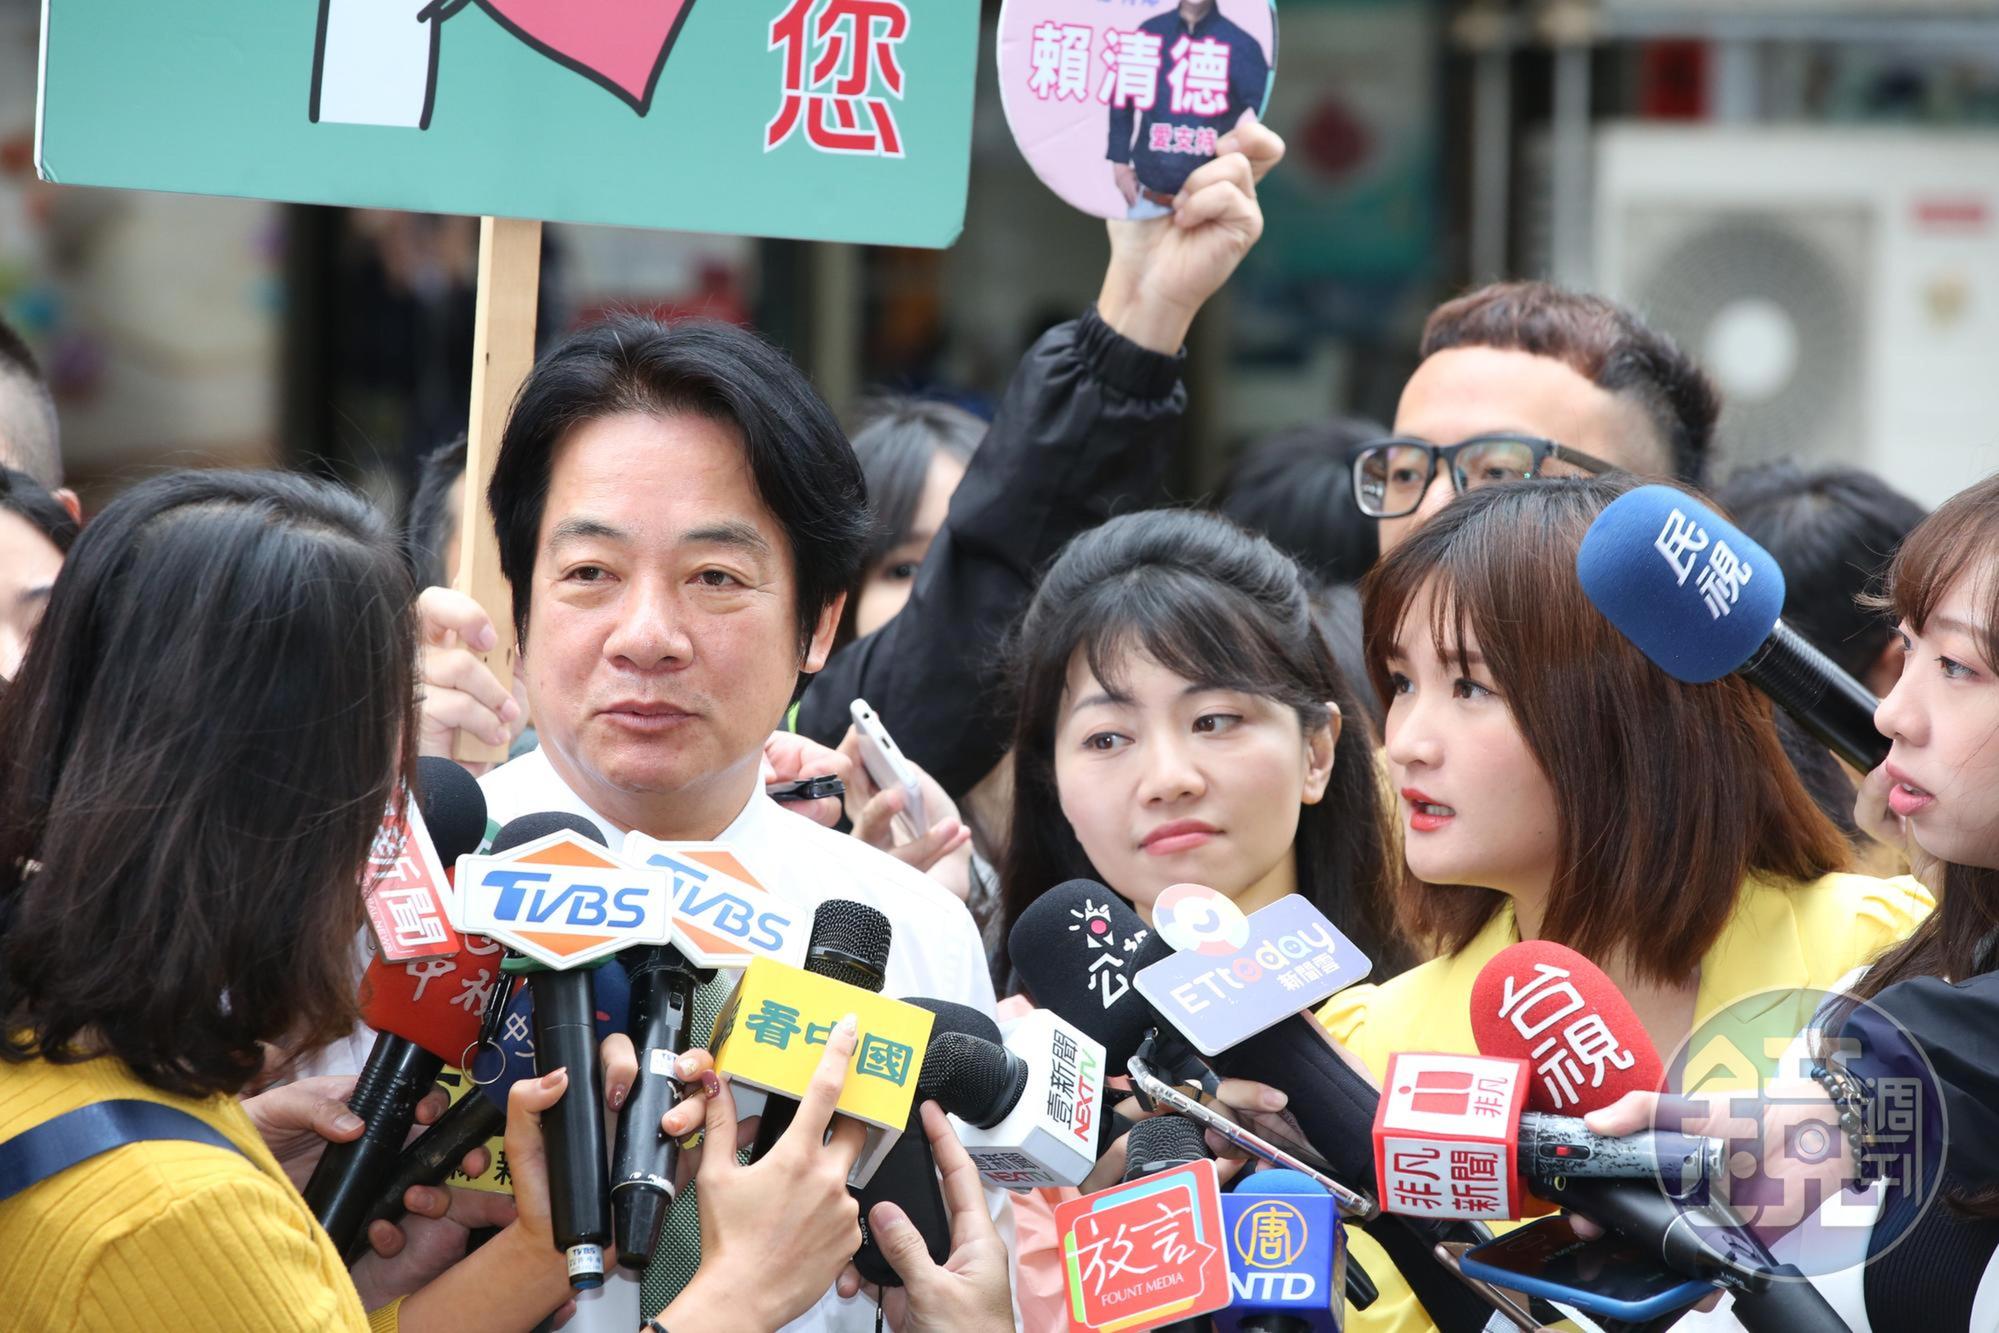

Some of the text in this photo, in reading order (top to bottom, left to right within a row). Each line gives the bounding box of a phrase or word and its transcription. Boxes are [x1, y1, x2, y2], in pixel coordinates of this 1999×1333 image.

[763, 0, 910, 158] 您
[1028, 21, 1230, 116] 賴清德
[1654, 508, 1753, 619] 民視
[368, 799, 449, 947] 新聞
[481, 870, 650, 928] TVBS
[1169, 922, 1336, 1014] ETtoday
[1276, 952, 1340, 991] 新聞雲
[1498, 963, 1635, 1108] 台視
[1047, 1028, 1078, 1130] 壹新聞
[1474, 1077, 1508, 1118] 非凡
[1393, 1147, 1442, 1209] 非凡
[1450, 1150, 1501, 1212] 新聞
[1066, 1202, 1197, 1296] 放言
[1244, 1206, 1293, 1266] 唐
[1101, 1272, 1185, 1307] FOUNT MEDIA
[1231, 1272, 1316, 1300] NTD
